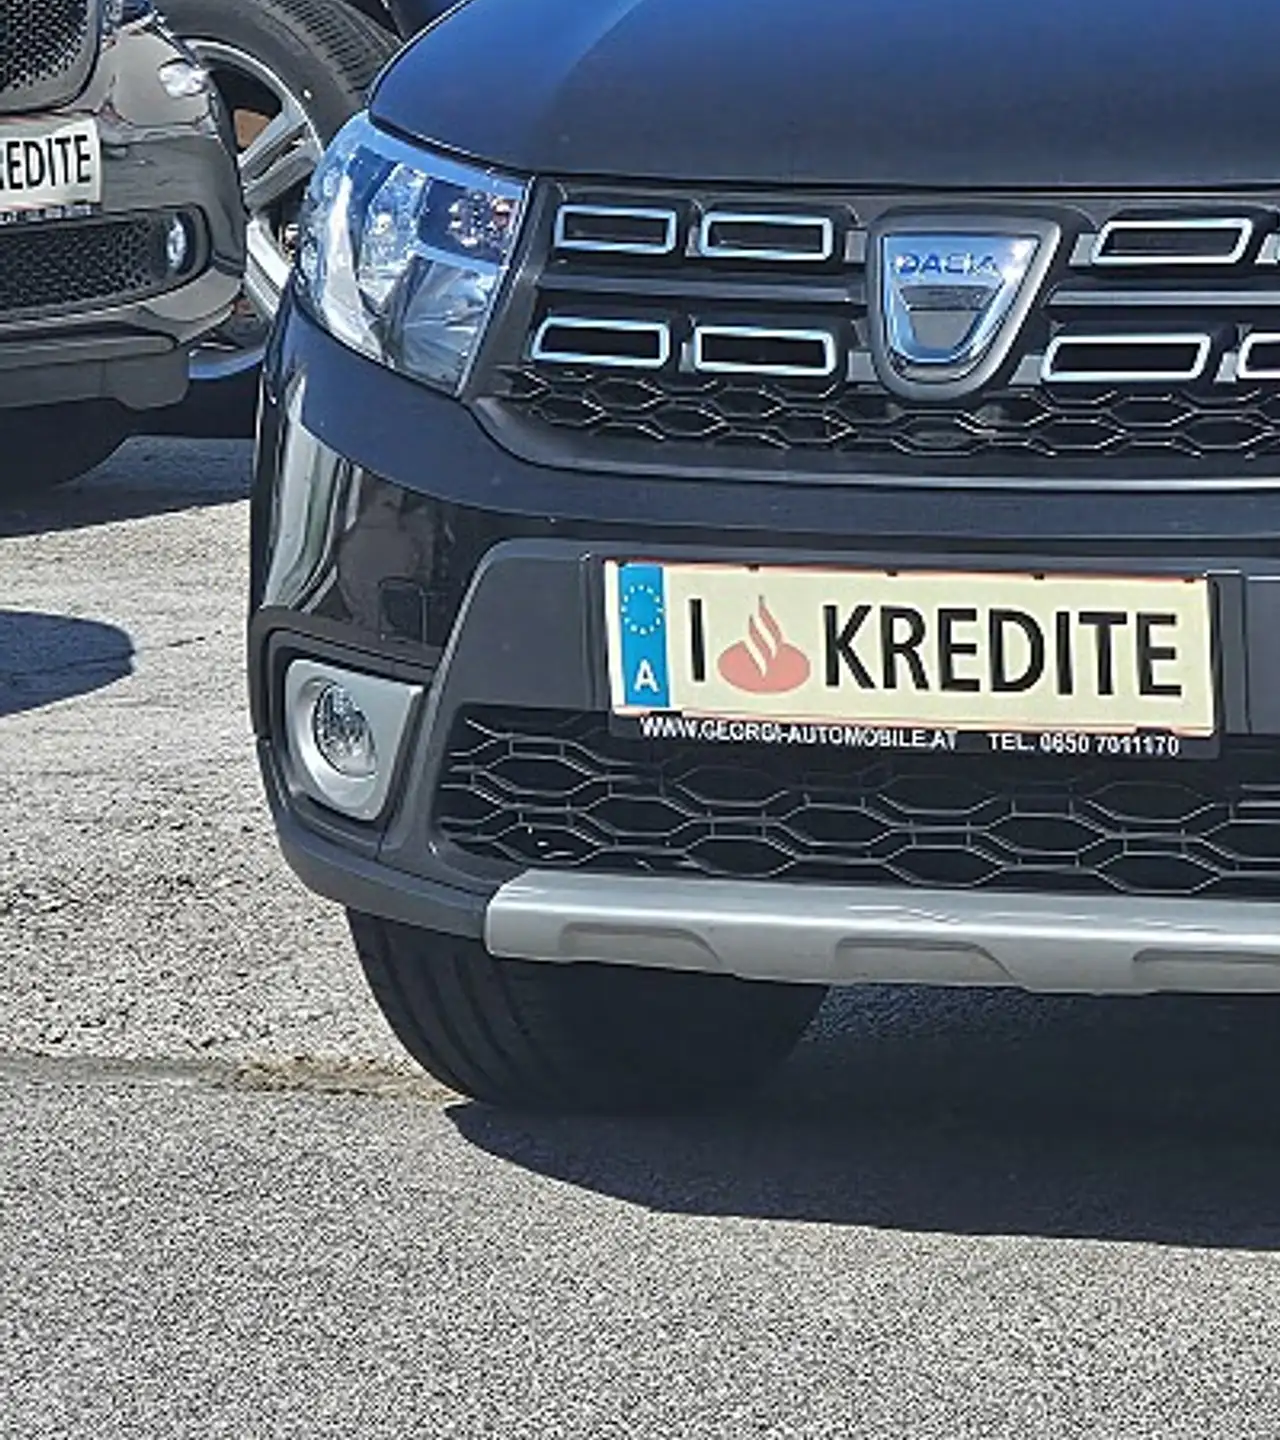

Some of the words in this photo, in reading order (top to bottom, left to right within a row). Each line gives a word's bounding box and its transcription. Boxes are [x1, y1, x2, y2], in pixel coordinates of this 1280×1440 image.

[689, 598, 706, 683] I
[822, 604, 1183, 697] KREDITE
[633, 661, 660, 693] A
[988, 731, 1035, 753] TEL.
[1039, 732, 1090, 756] 0650
